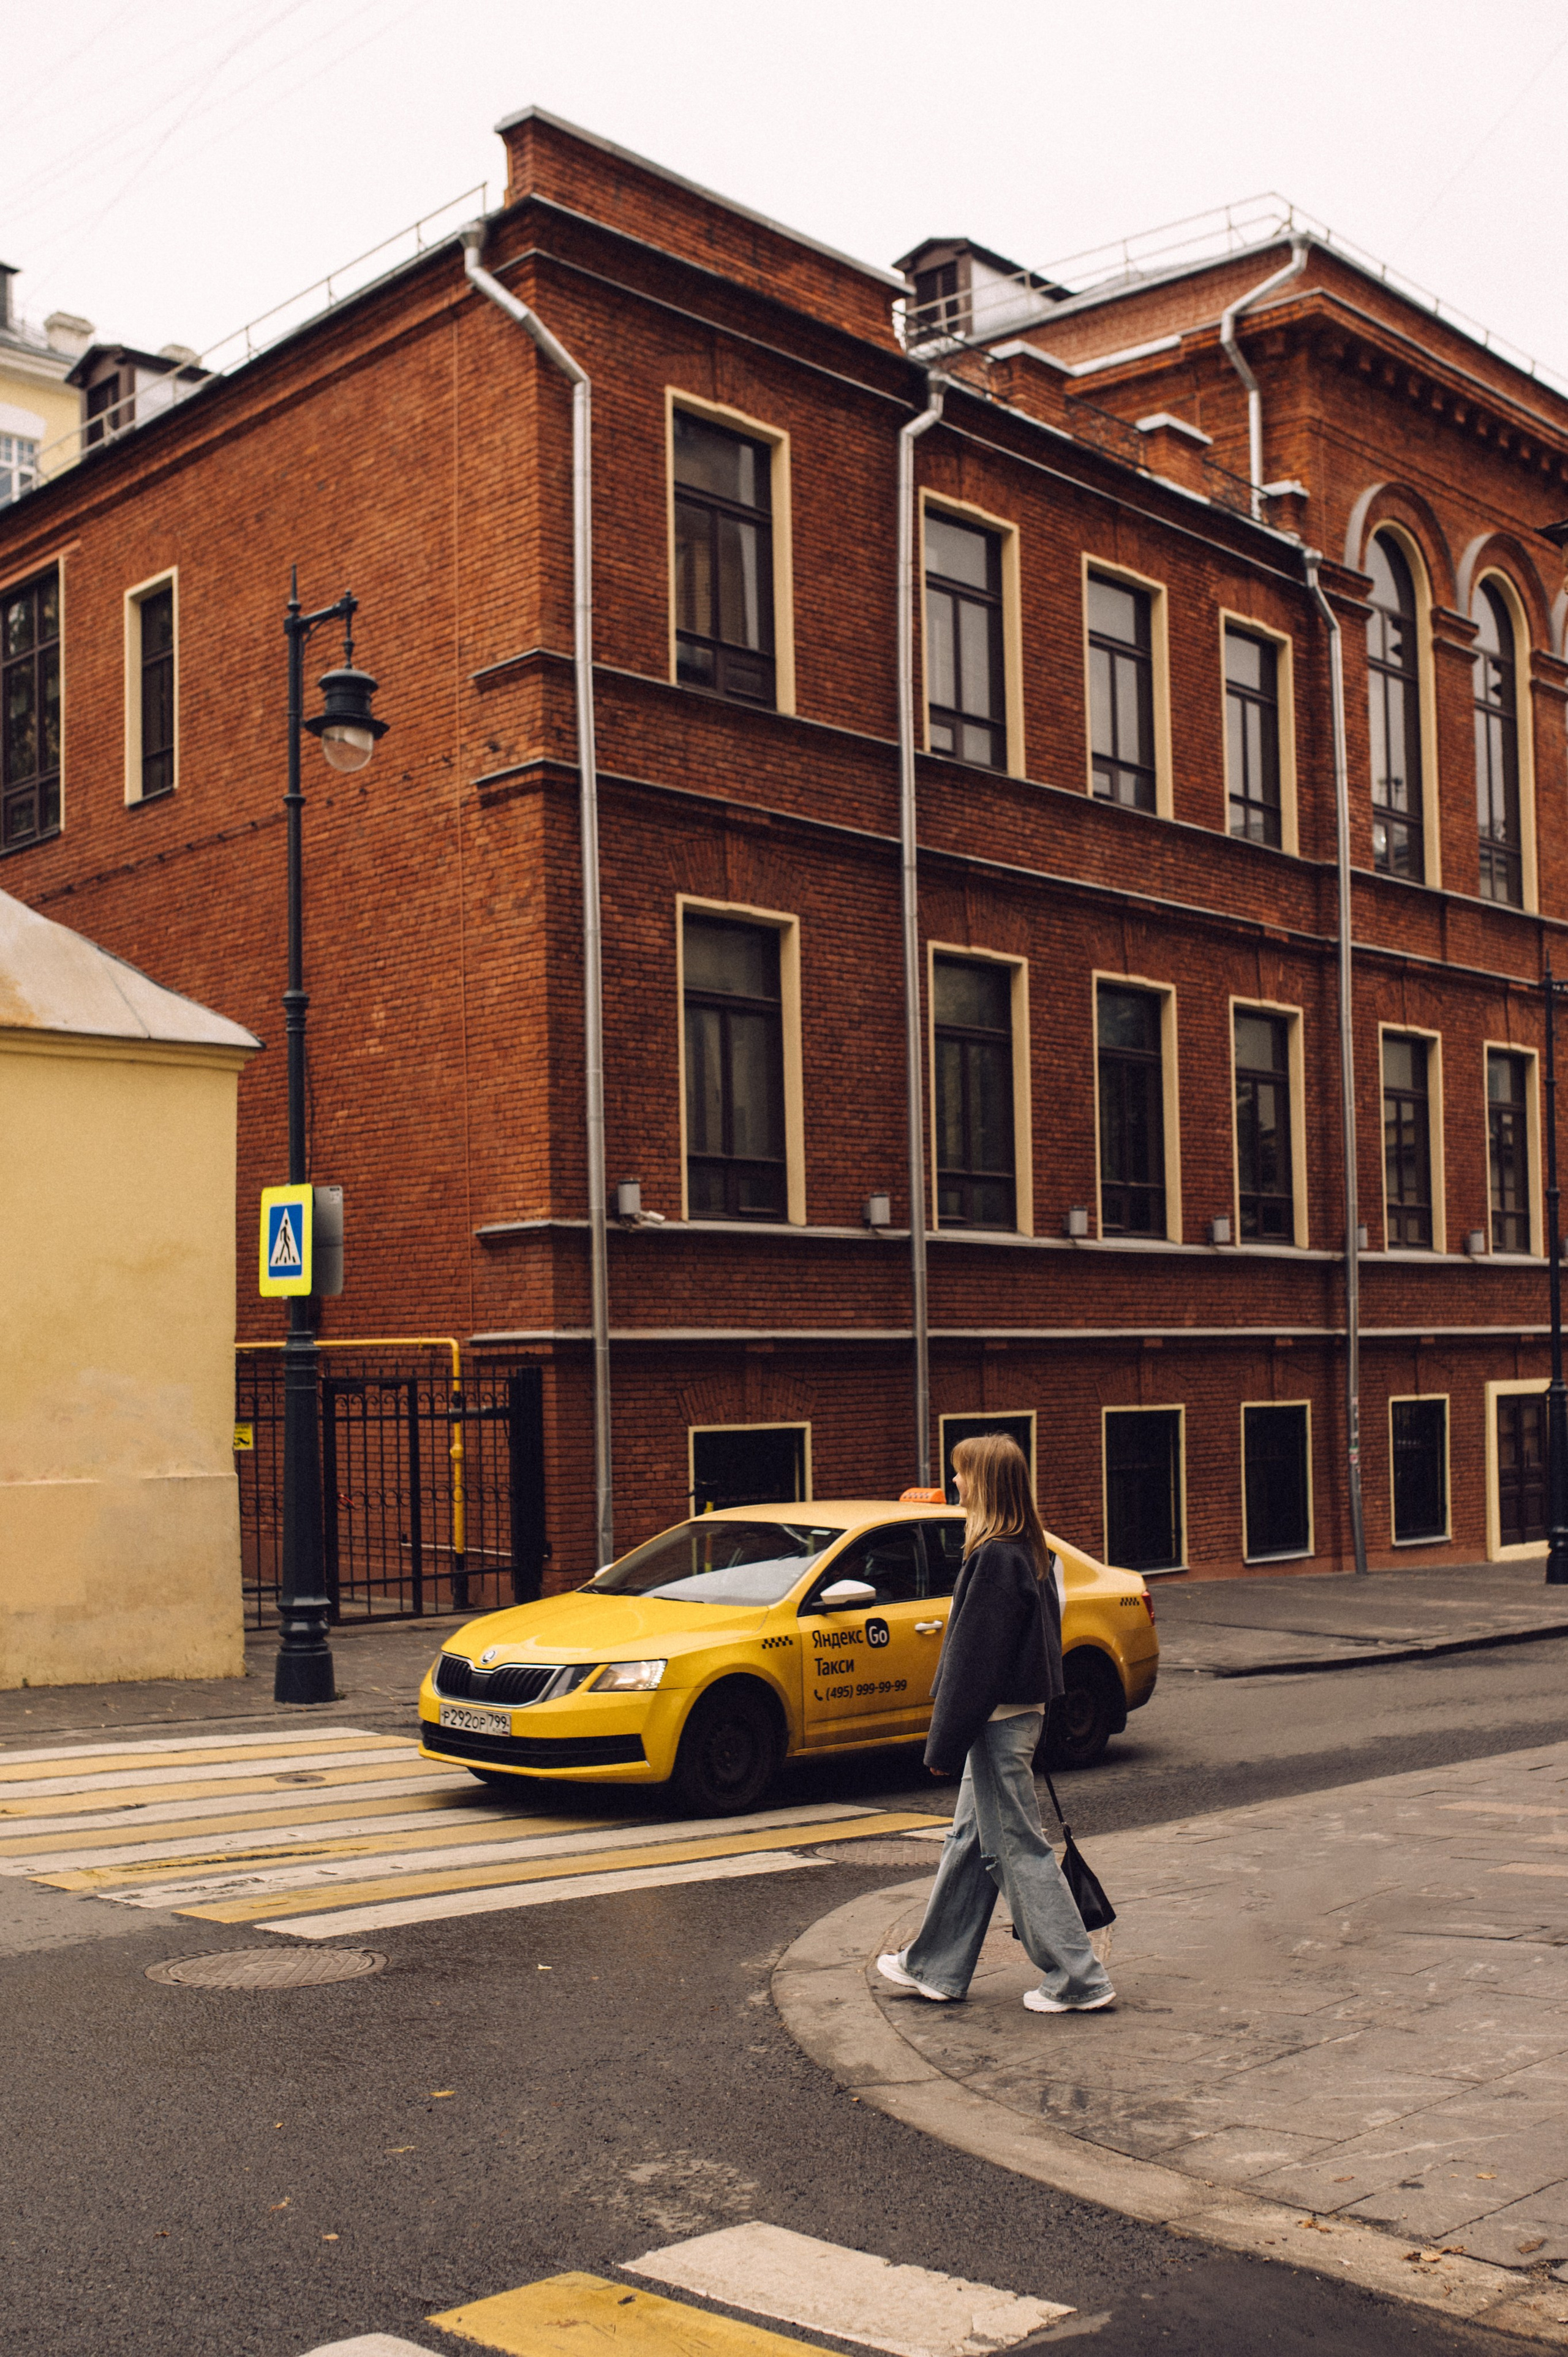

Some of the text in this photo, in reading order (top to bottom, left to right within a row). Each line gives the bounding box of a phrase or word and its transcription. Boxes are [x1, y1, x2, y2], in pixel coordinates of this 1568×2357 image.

[812, 1625, 888, 1649] Яндекс Go
[815, 1657, 854, 1676] Такси
[826, 1679, 907, 1701] (495) 999-99-99
[488, 1714, 507, 1729] 799
